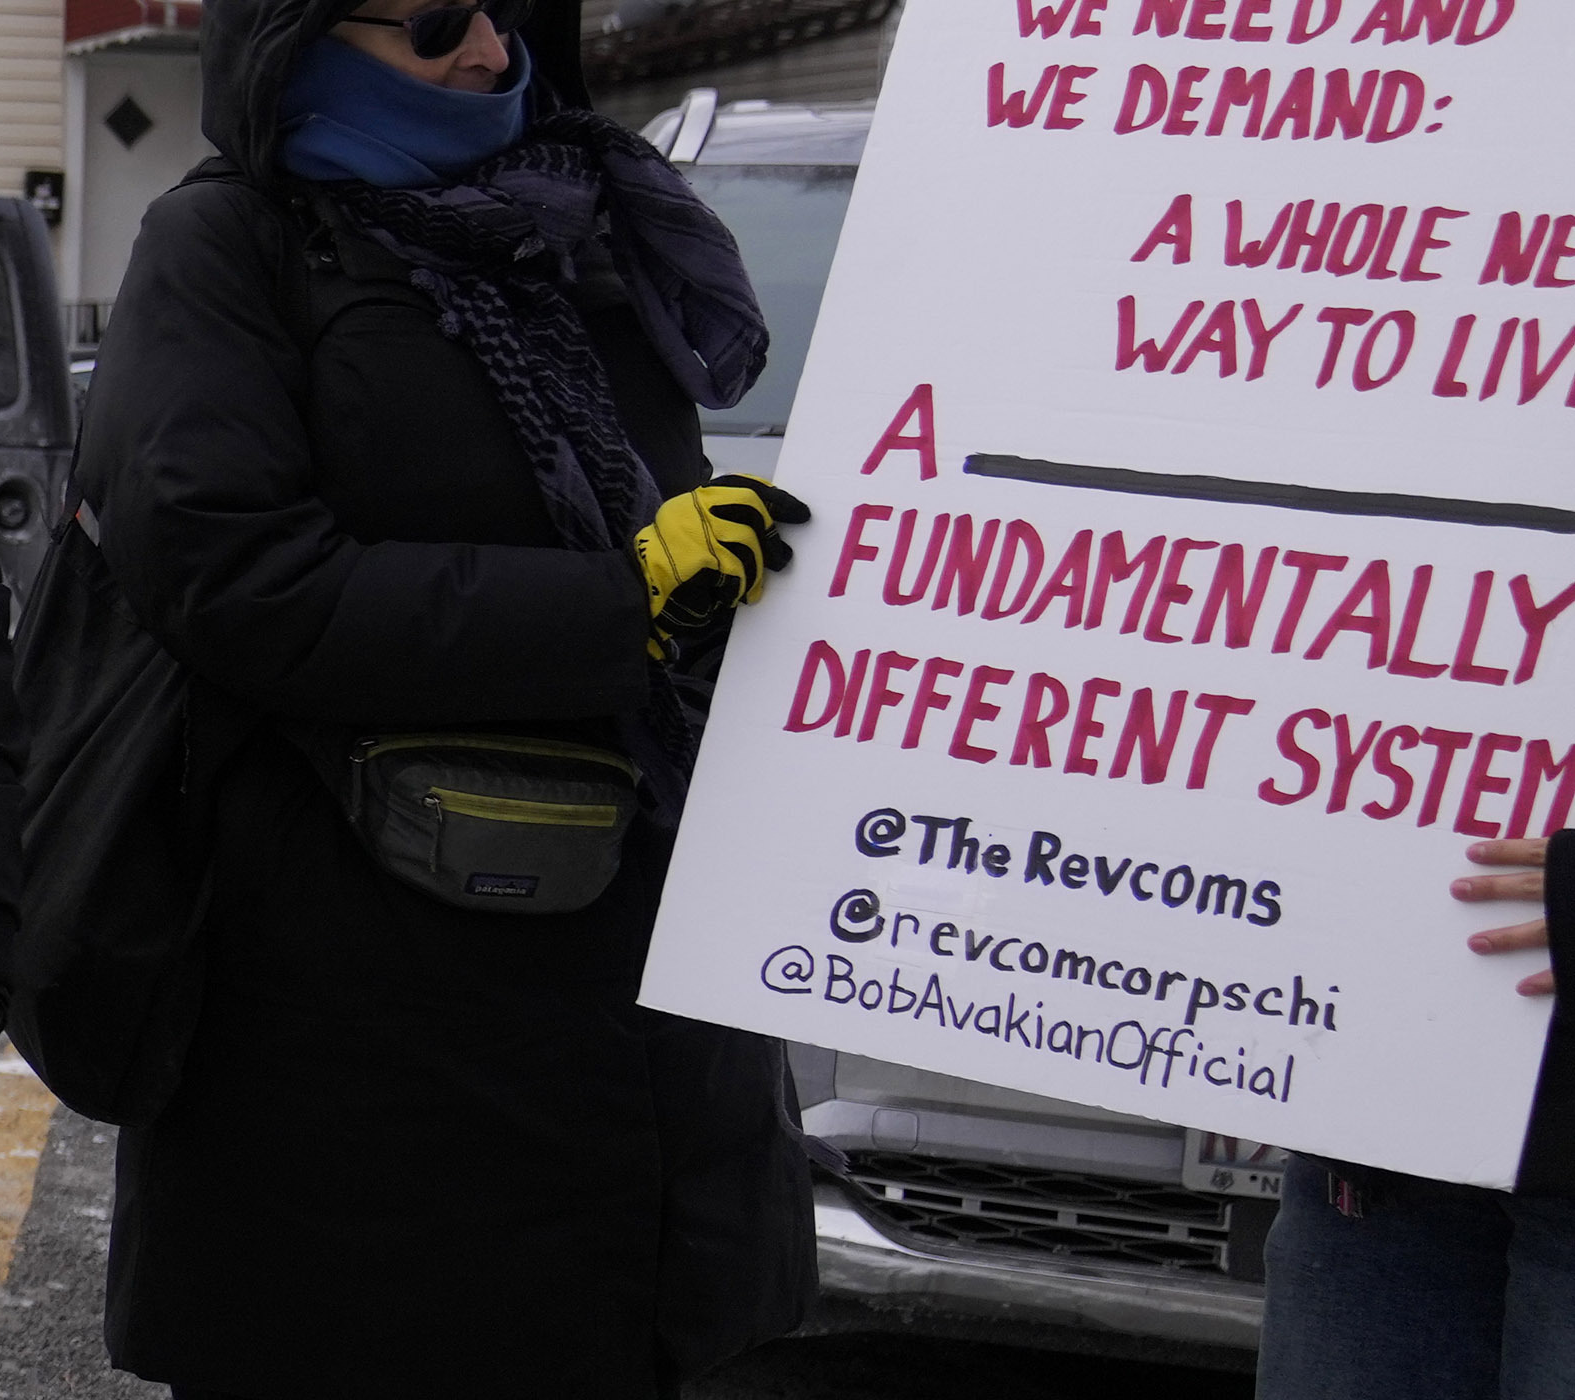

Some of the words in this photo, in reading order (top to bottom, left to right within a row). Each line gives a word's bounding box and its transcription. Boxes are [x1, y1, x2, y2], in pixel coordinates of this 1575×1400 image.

[987, 62, 1101, 129] WE
[1111, 66, 1447, 143] DEMAND:
[1130, 193, 1195, 264] A
[1224, 199, 1471, 283] WHOLE
[1114, 296, 1305, 386] WAY
[1315, 305, 1416, 396] TO
[1431, 312, 1575, 407] LIV
[862, 383, 938, 481] A
[828, 503, 1575, 686] FUNDAMENTALLY
[782, 639, 1255, 791] DIFFERENT
[1257, 705, 1575, 839] SYSTEM
[760, 945, 1294, 1102] @BobAvakianOfficial
